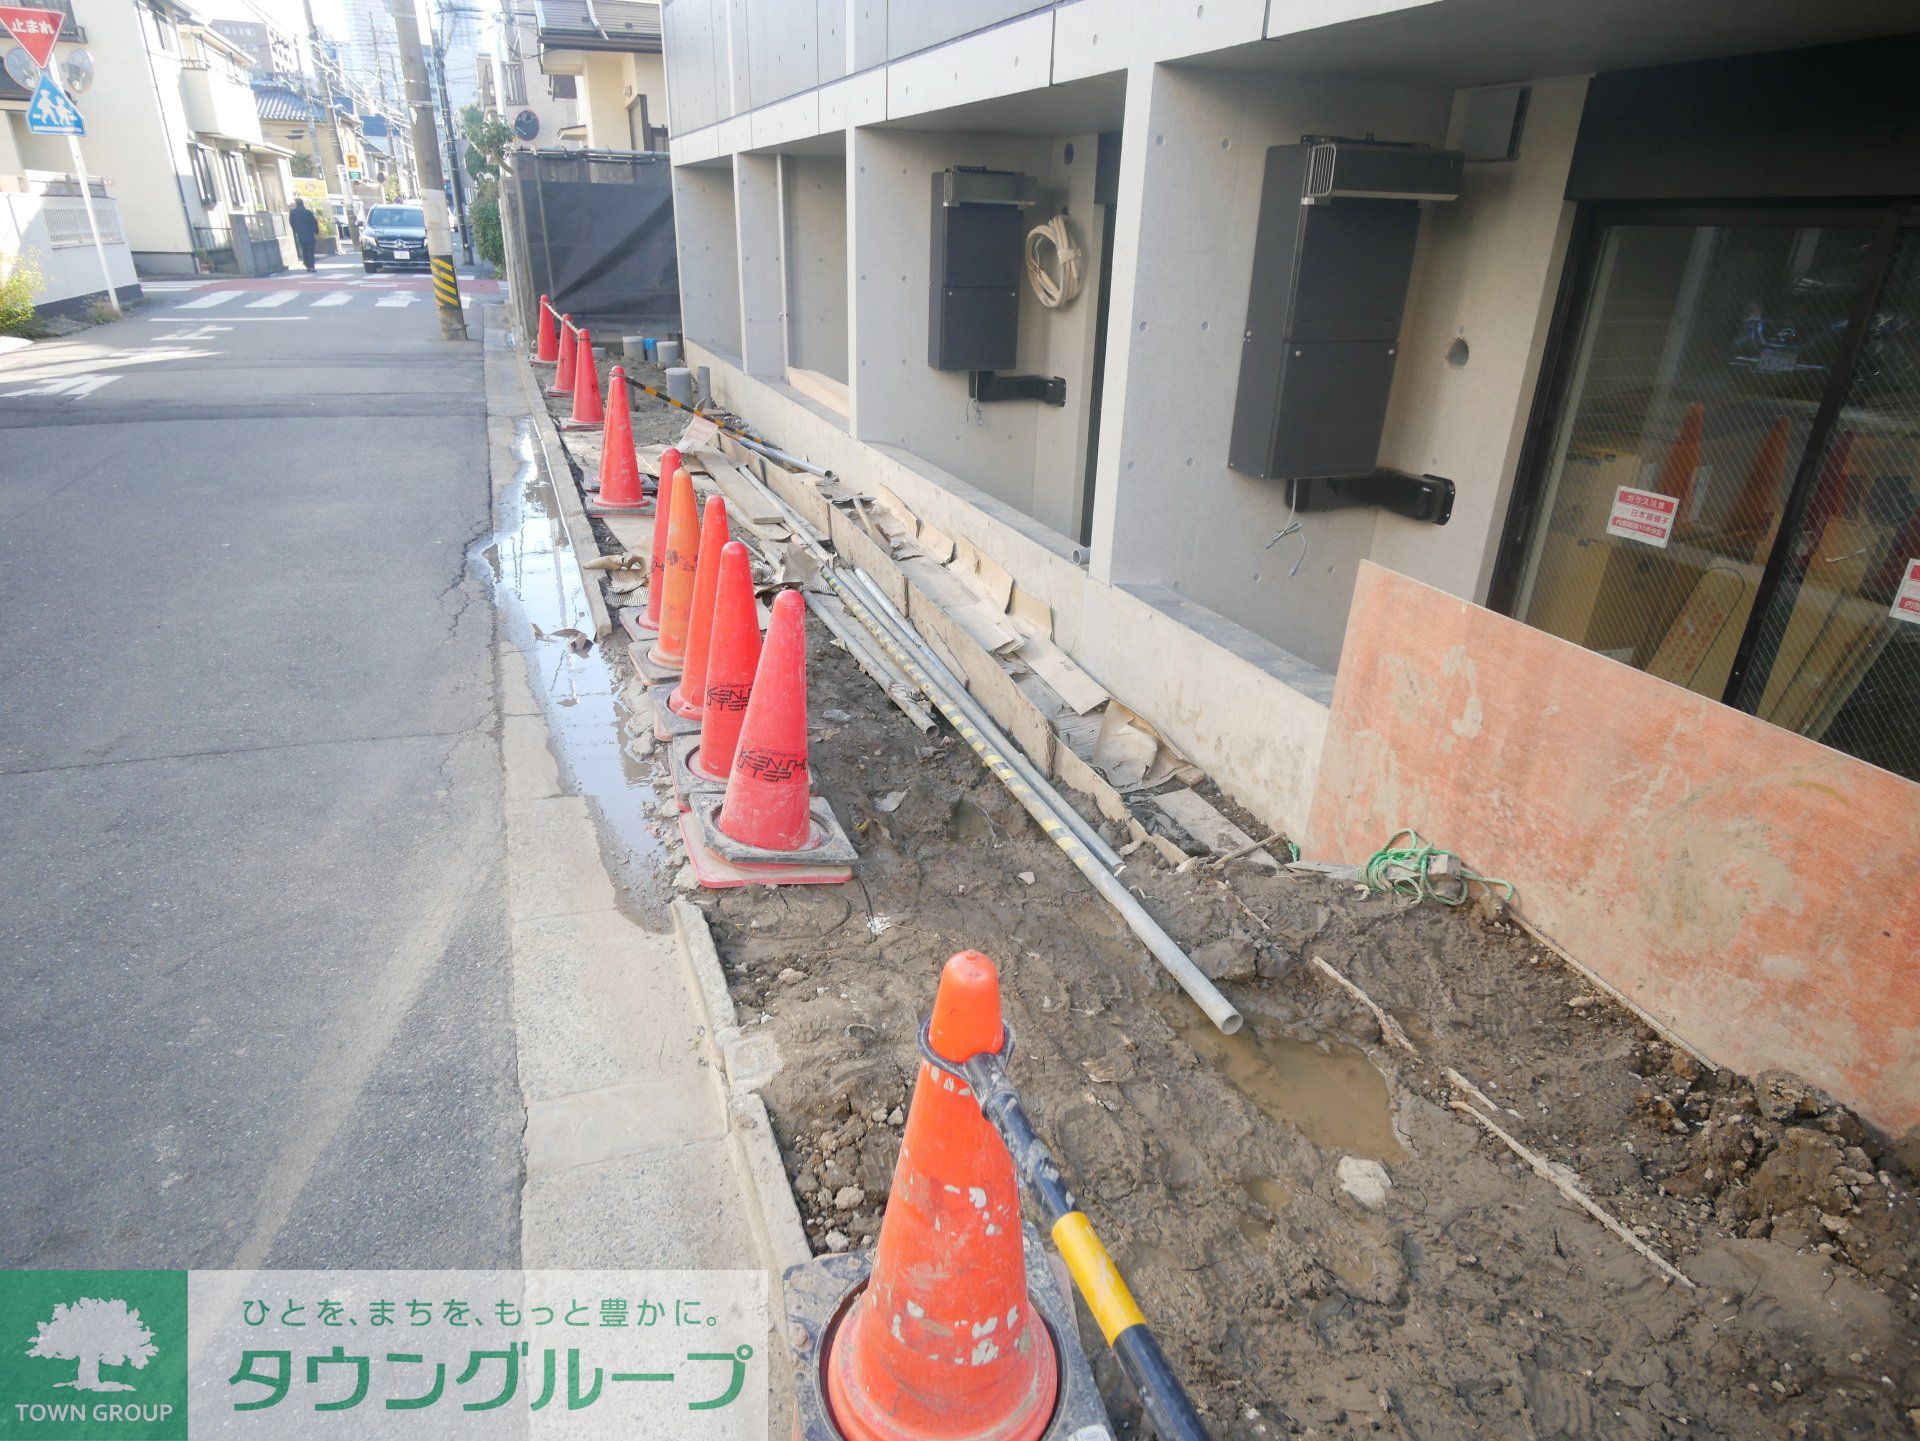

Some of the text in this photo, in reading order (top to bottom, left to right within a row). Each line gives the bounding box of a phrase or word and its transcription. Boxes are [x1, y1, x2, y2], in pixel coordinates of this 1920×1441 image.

[12, 18, 55, 35] 止まれ
[347, 155, 358, 168] P
[1626, 494, 1665, 510] ガラス注意
